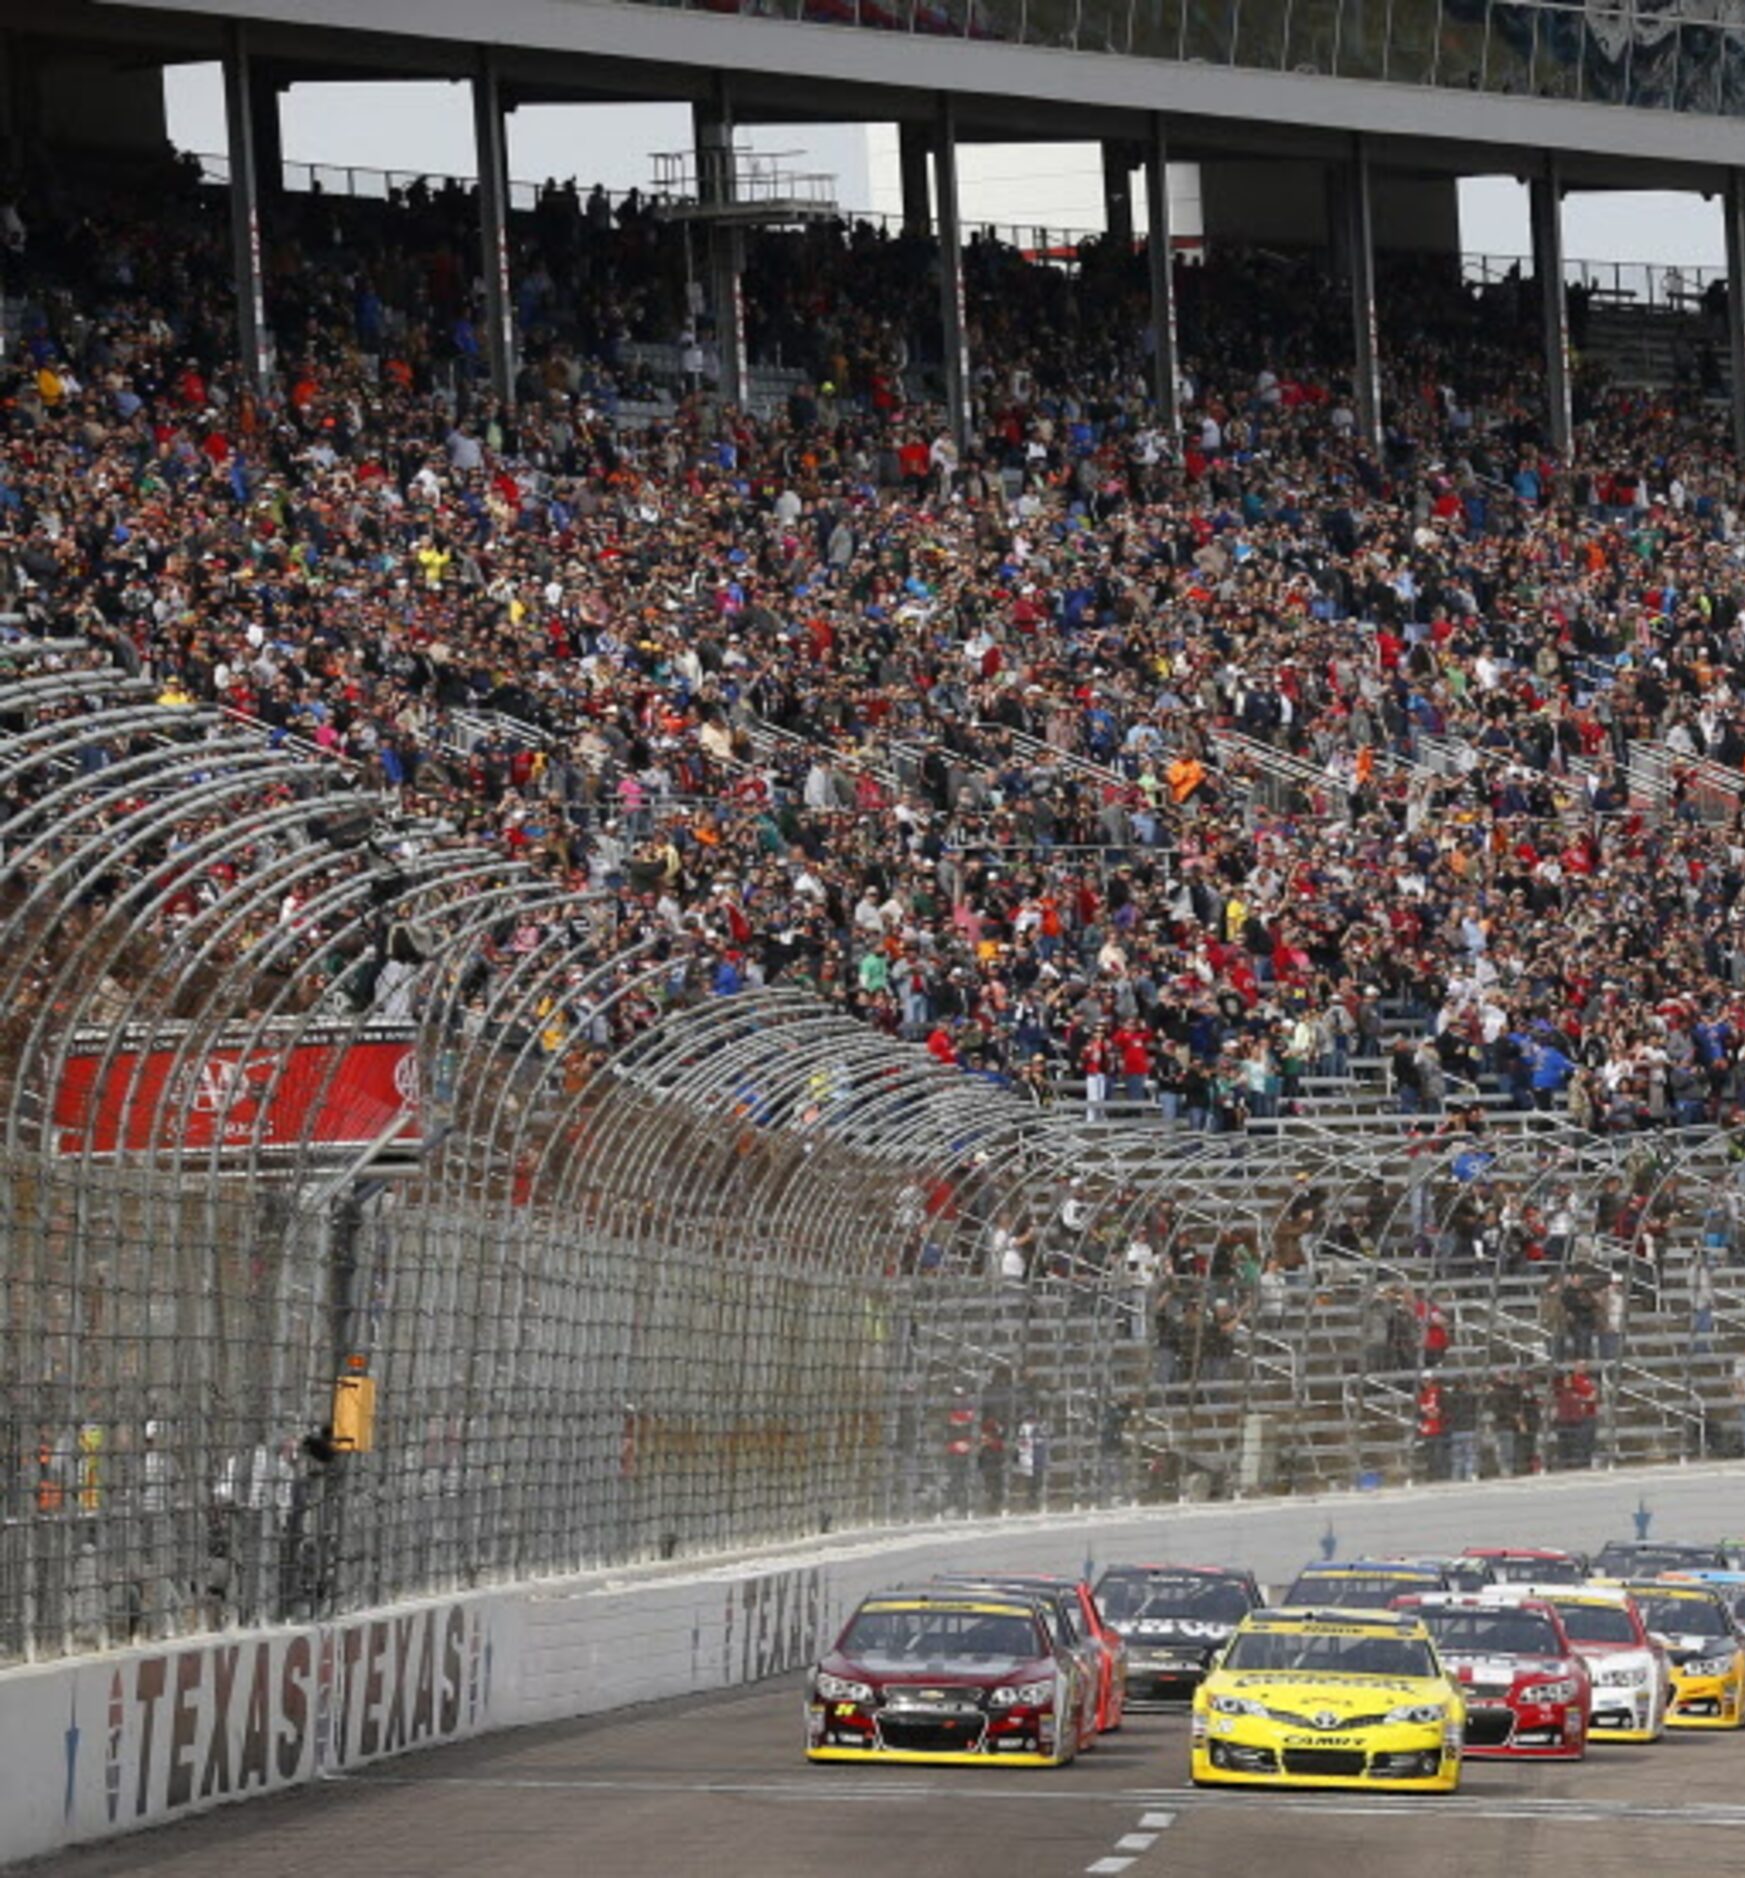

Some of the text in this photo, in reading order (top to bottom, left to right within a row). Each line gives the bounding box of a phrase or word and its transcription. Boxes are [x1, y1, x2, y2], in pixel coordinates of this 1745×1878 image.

[338, 1605, 464, 1765] TEXAS
[741, 1568, 818, 1684] TEXAS
[136, 1635, 311, 1817] TEXAS
[1283, 1735, 1367, 1746] CAMRY
